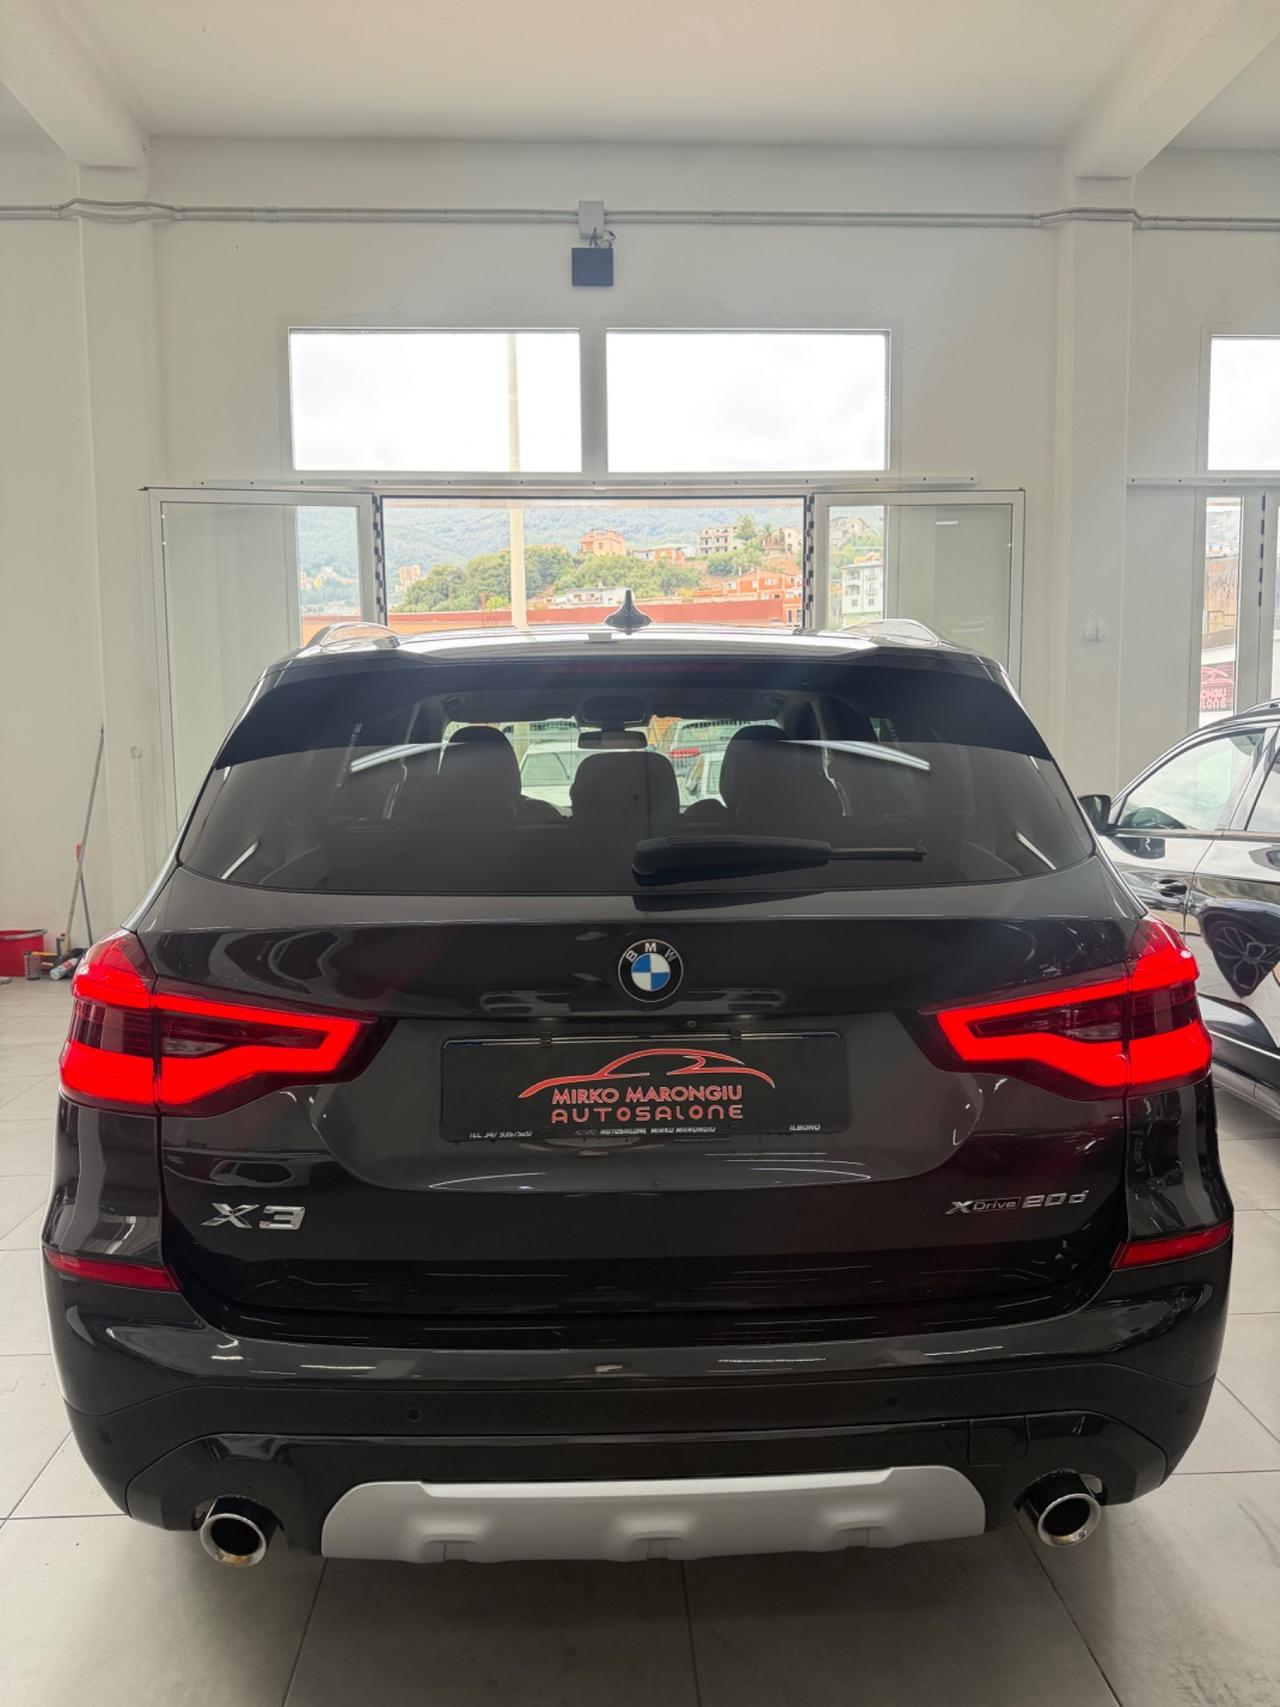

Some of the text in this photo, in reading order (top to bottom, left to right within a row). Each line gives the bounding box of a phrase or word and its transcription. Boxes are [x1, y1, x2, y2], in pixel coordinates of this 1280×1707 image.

[625, 942, 678, 962] BMW
[552, 1085, 743, 1105] MIRKO MARONGIU
[551, 1104, 744, 1124] AUTOSALONE
[200, 1202, 306, 1230] X3
